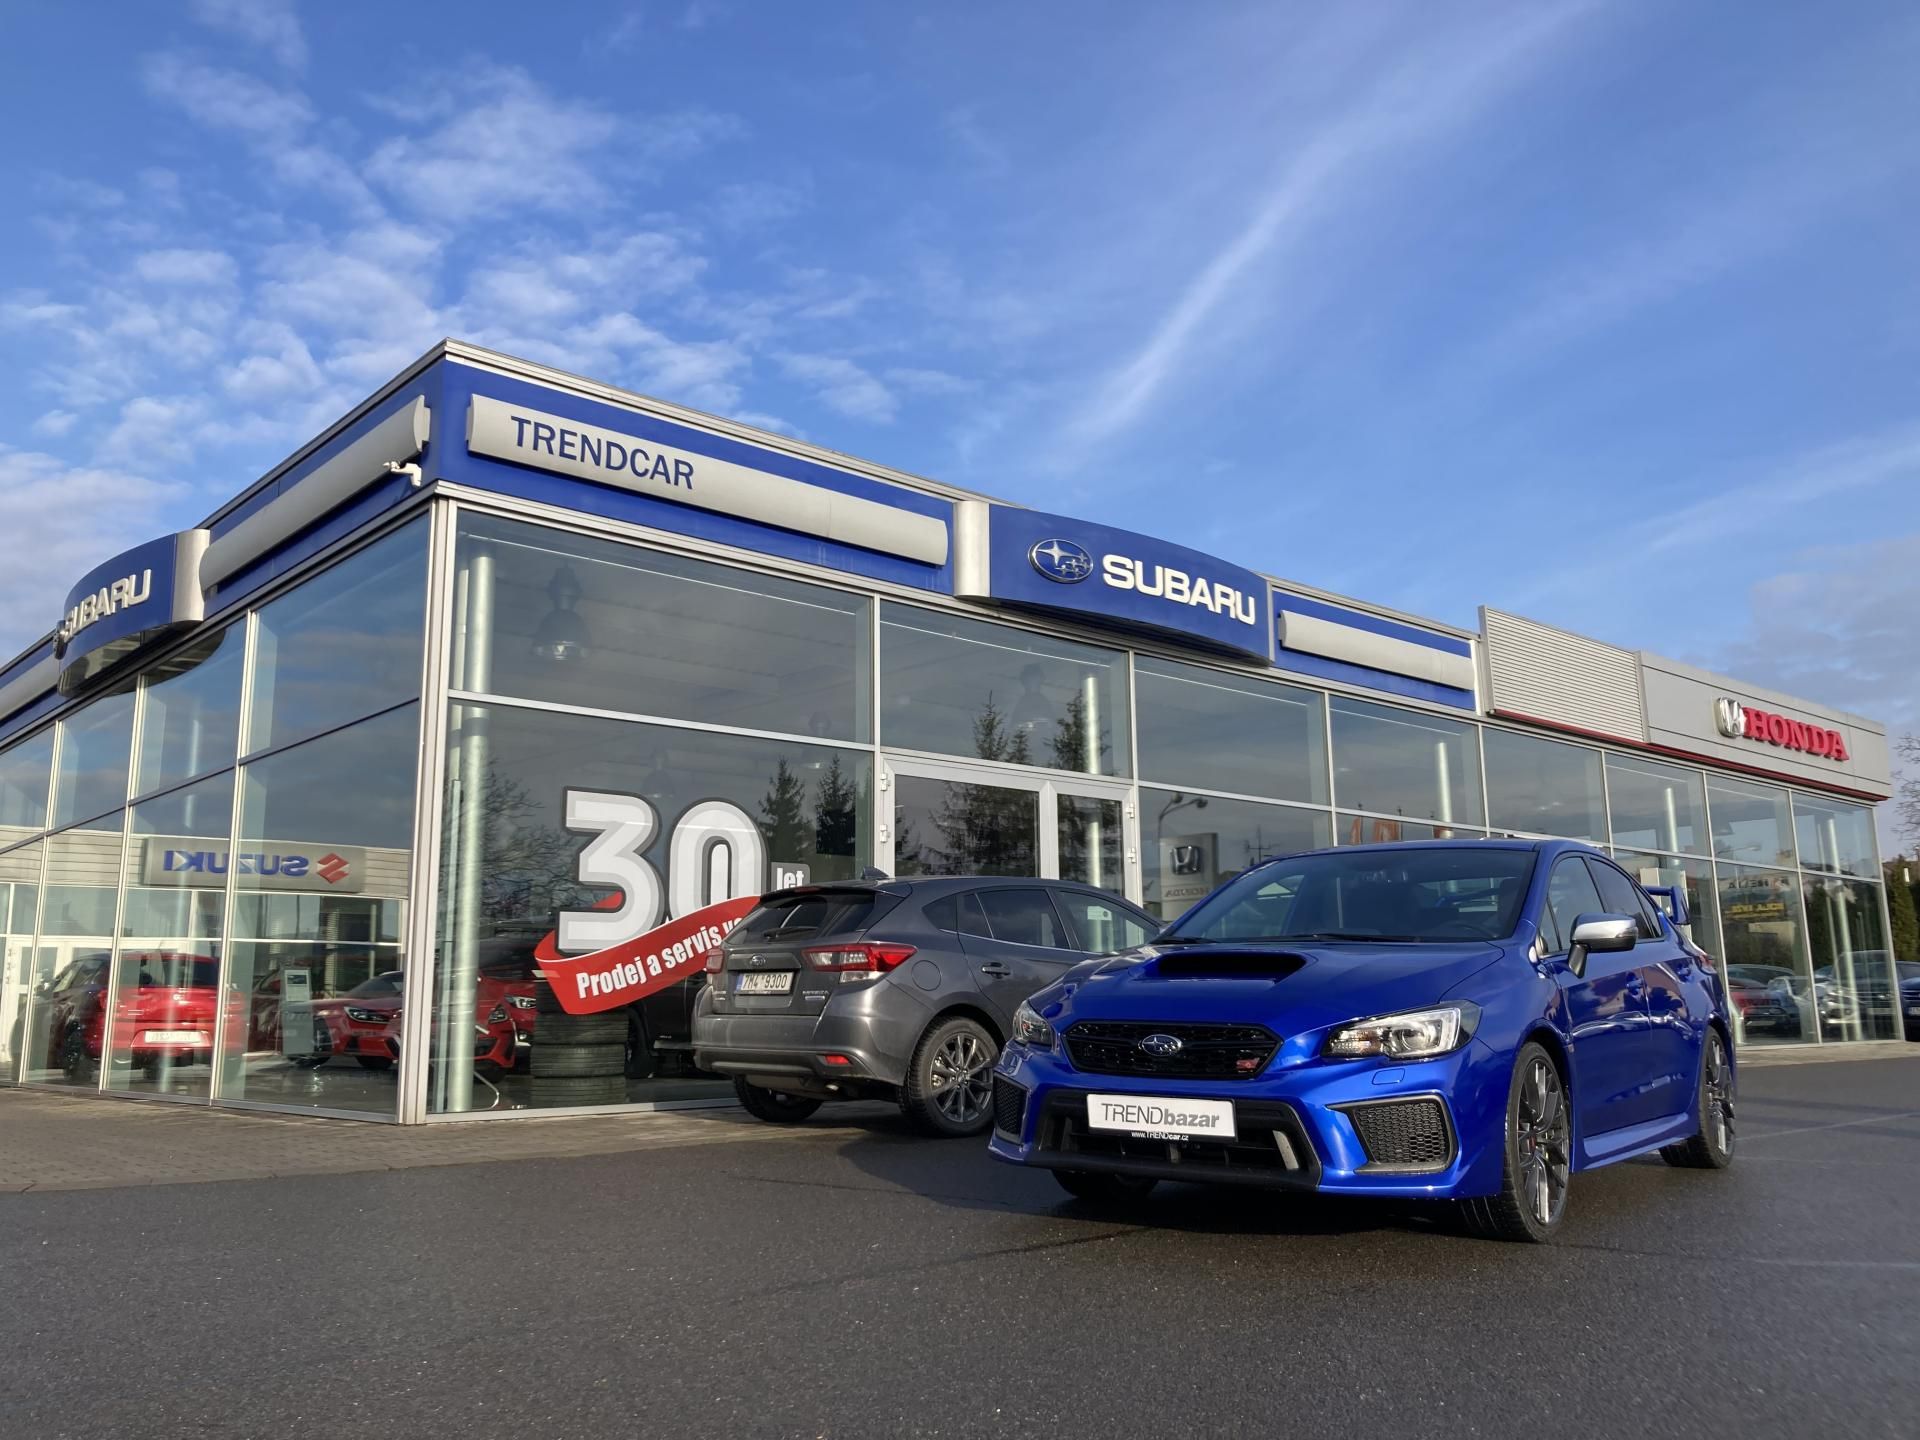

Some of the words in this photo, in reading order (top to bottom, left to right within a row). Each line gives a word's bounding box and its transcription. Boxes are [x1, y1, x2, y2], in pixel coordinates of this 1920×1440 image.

[511, 415, 694, 490] TRENDCAR
[1102, 554, 1256, 625] SUBARU
[1743, 707, 1850, 761] HONDA
[557, 786, 768, 951] 30
[776, 867, 805, 891] let
[576, 956, 647, 999] Prodej
[646, 954, 662, 976] a
[661, 926, 722, 969] servis
[764, 974, 788, 989] 9300
[1101, 1103, 1220, 1128] TRENDbazar
[1131, 1131, 1189, 1141] www.TRENDcar.cz
